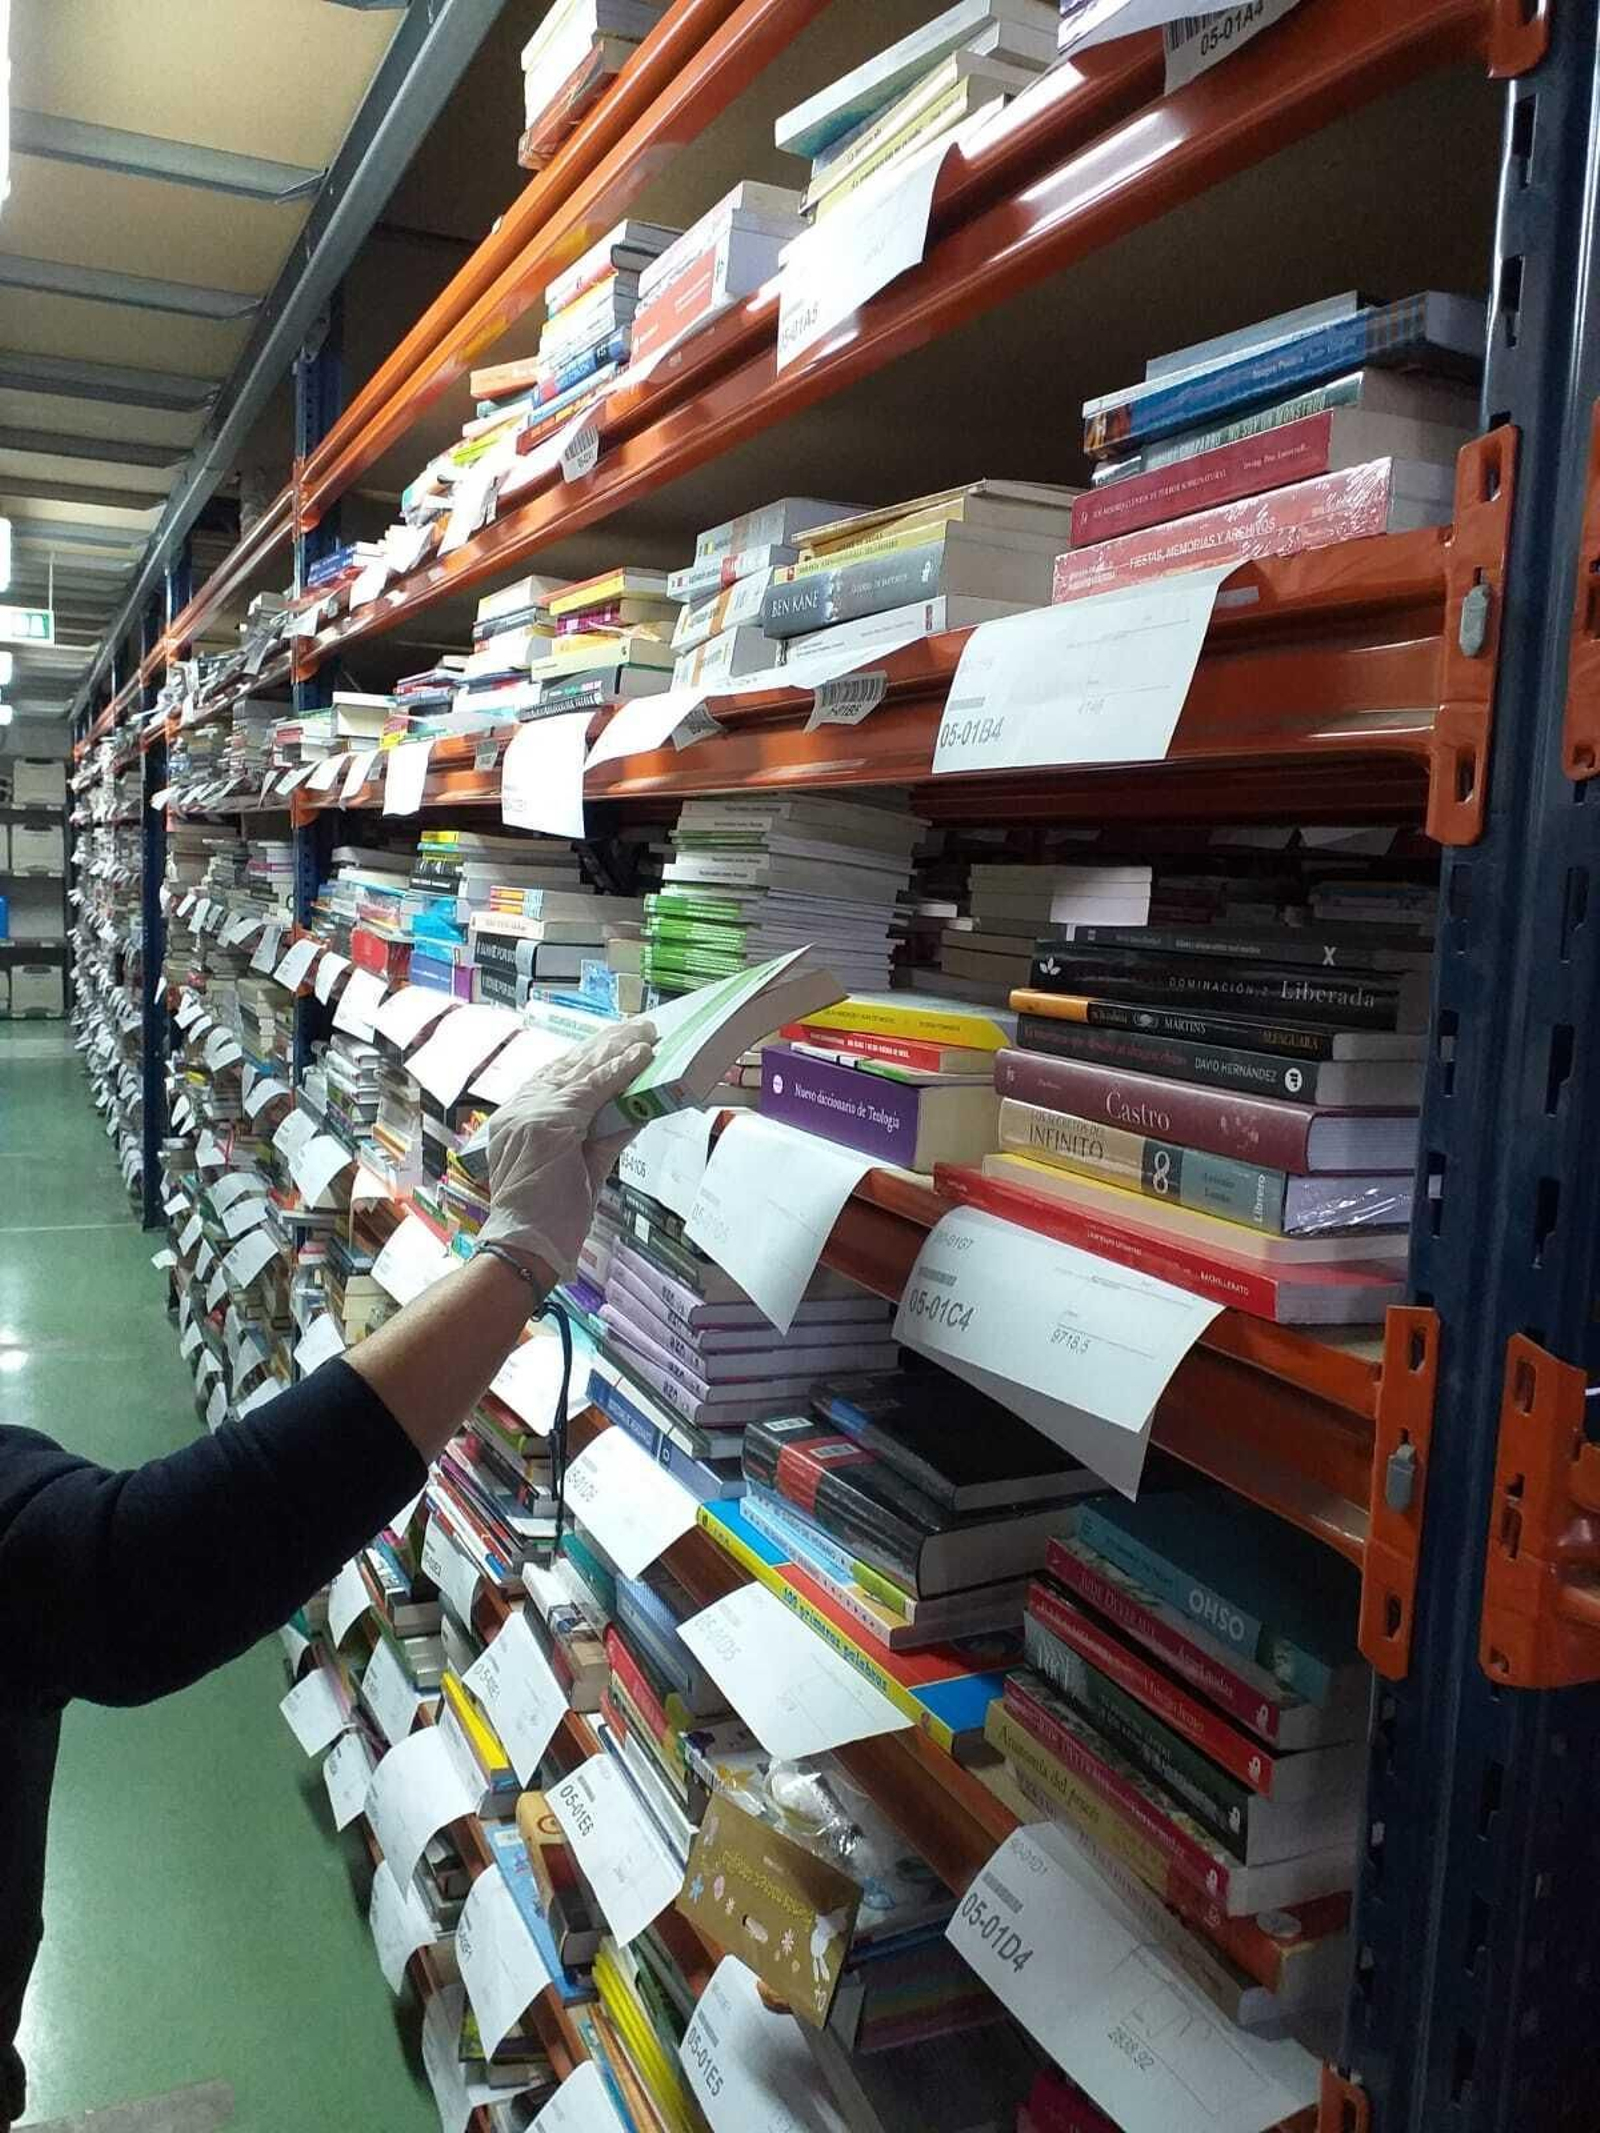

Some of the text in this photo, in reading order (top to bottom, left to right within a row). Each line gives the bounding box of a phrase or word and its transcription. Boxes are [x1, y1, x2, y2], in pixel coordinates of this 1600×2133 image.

[1201, 2, 1264, 55] 05-01A4
[771, 590, 819, 619] BEN KANE
[940, 716, 1005, 749] 05-01B4
[1280, 980, 1376, 1009] Liberada
[1195, 1057, 1278, 1084] DAVID HERNÁNDEZ
[857, 1103, 868, 1118] de
[1105, 1089, 1171, 1133] Castro
[1028, 1123, 1105, 1161] INFINITO
[1252, 1172, 1268, 1224] Librero
[908, 1288, 976, 1333] 05-01C4
[560, 1783, 595, 1837] 05-01E6
[961, 1892, 1035, 1974] 05-01D4
[687, 2026, 724, 2097] 05-01E5
